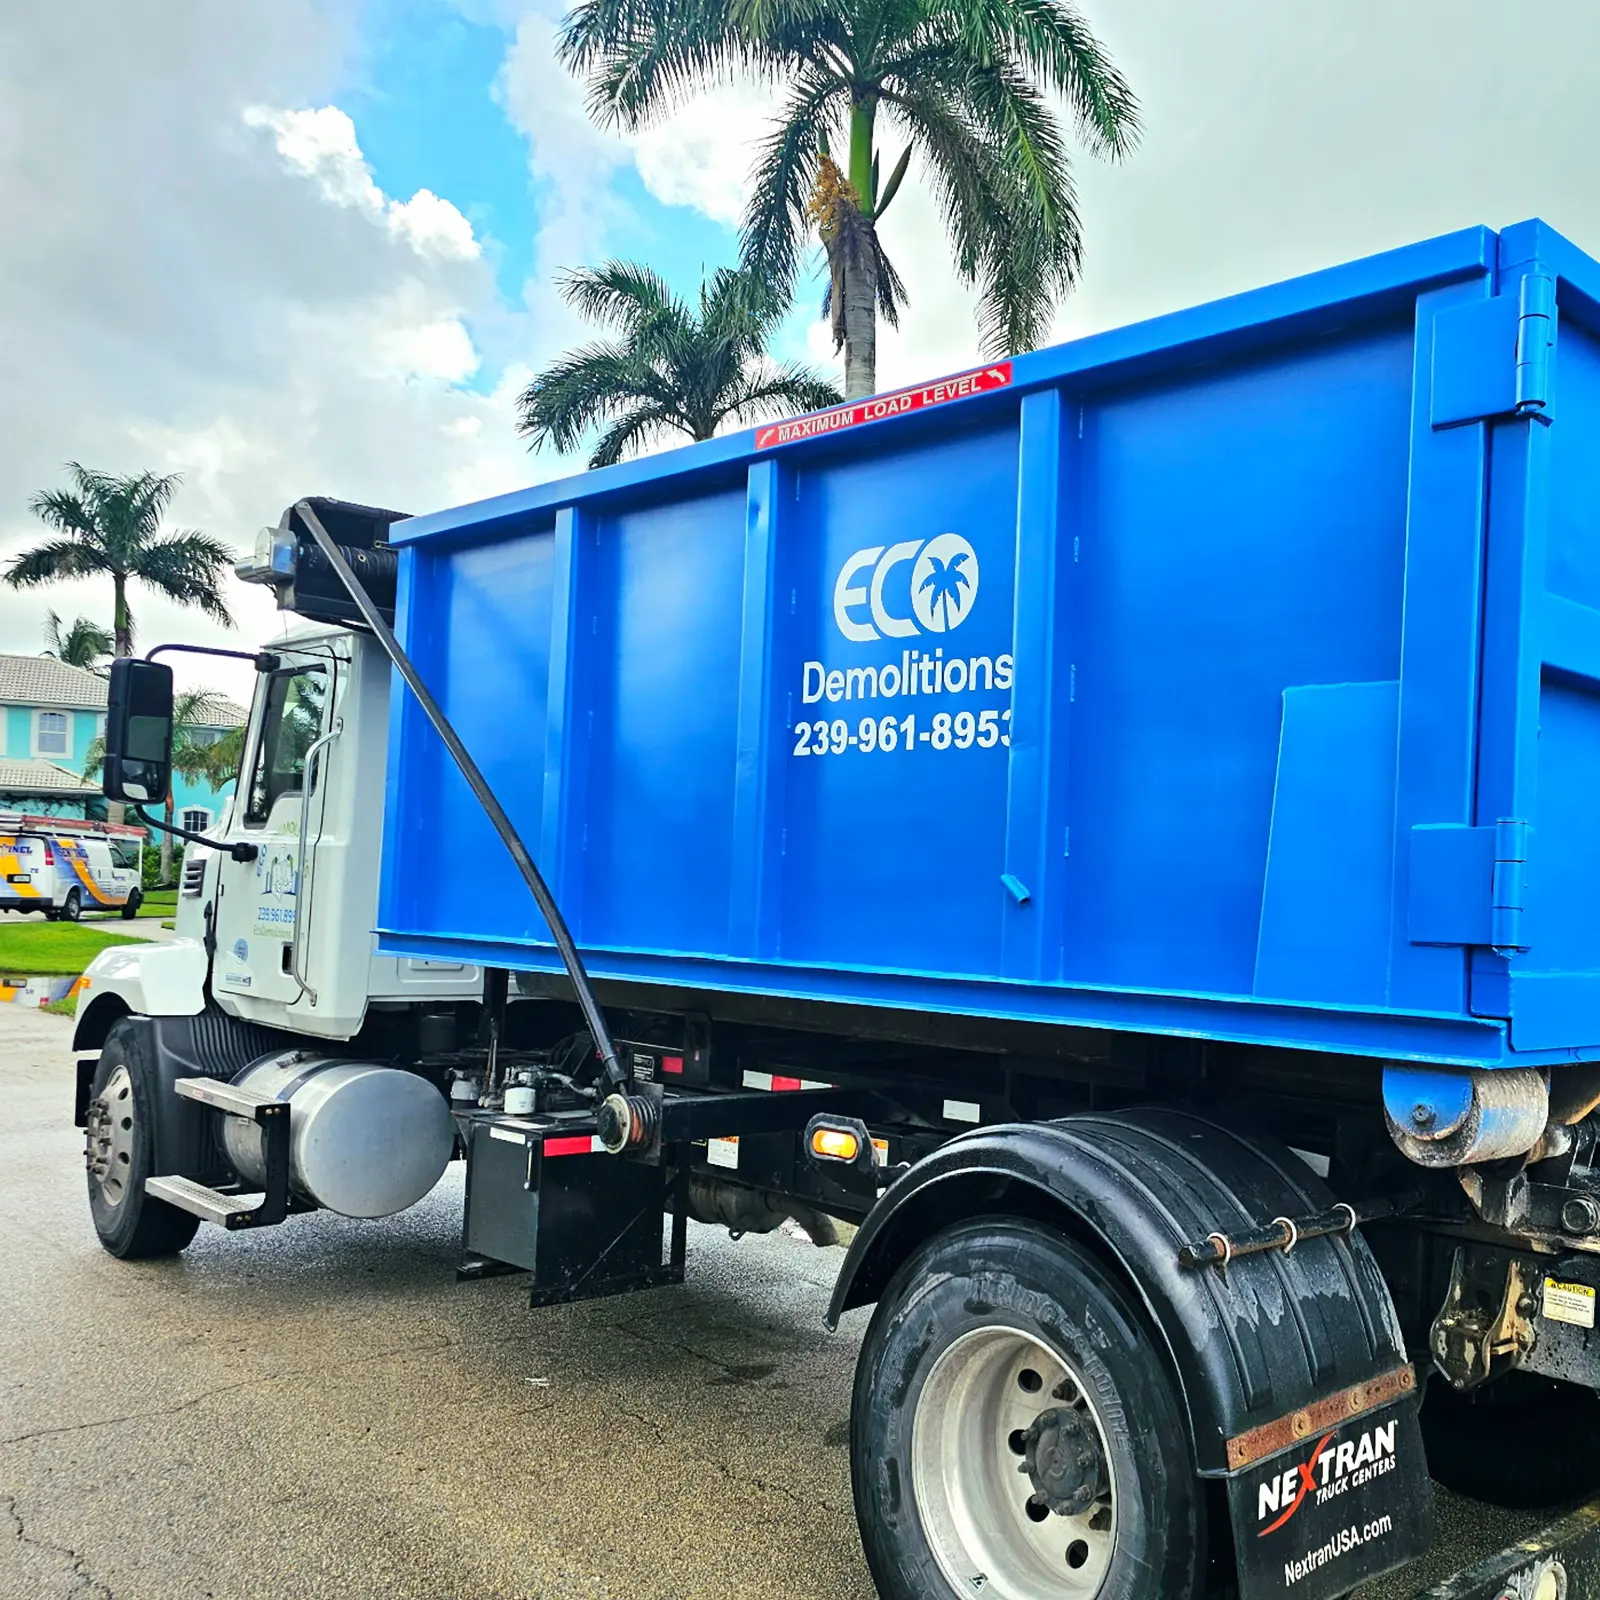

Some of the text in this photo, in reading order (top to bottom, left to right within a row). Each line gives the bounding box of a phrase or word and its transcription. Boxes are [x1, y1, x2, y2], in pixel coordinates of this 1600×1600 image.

[778, 378, 982, 442] MAXIMUM LOAD LEVEL
[833, 533, 979, 642] ECO
[802, 648, 1013, 704] Demolitions
[1557, 1283, 1589, 1296] CAUTION
[1257, 1420, 1396, 1536] NEXTRAN
[1315, 1454, 1396, 1506] TRUCK CENTERS
[1284, 1514, 1393, 1587] NextranUSA.com
